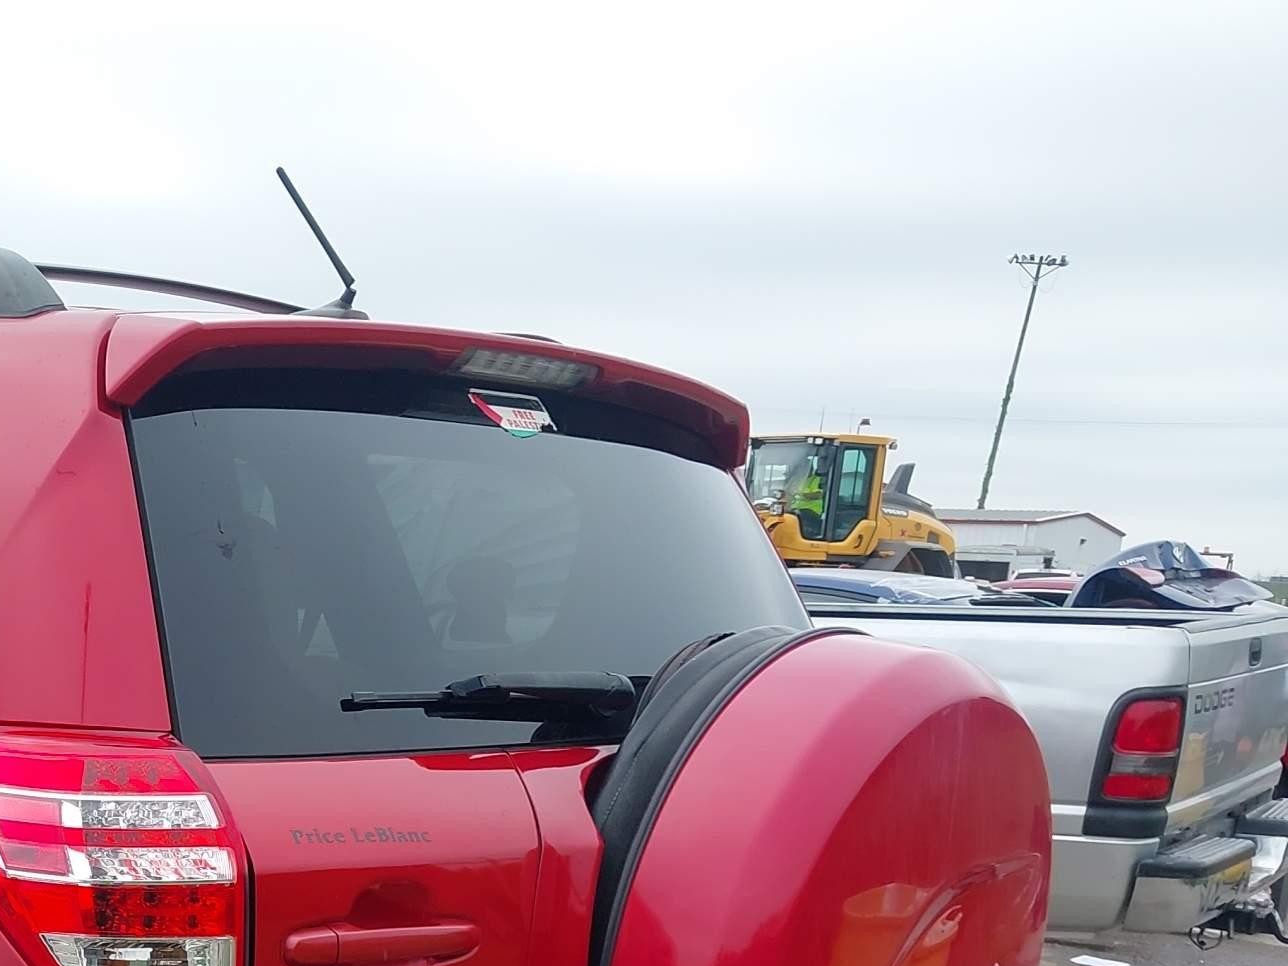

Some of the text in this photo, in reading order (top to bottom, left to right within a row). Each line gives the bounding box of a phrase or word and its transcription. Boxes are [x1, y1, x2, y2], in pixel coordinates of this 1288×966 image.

[511, 409, 537, 421] FREE
[1194, 687, 1235, 714] DODGE
[289, 825, 433, 845] Price LeBlanc
